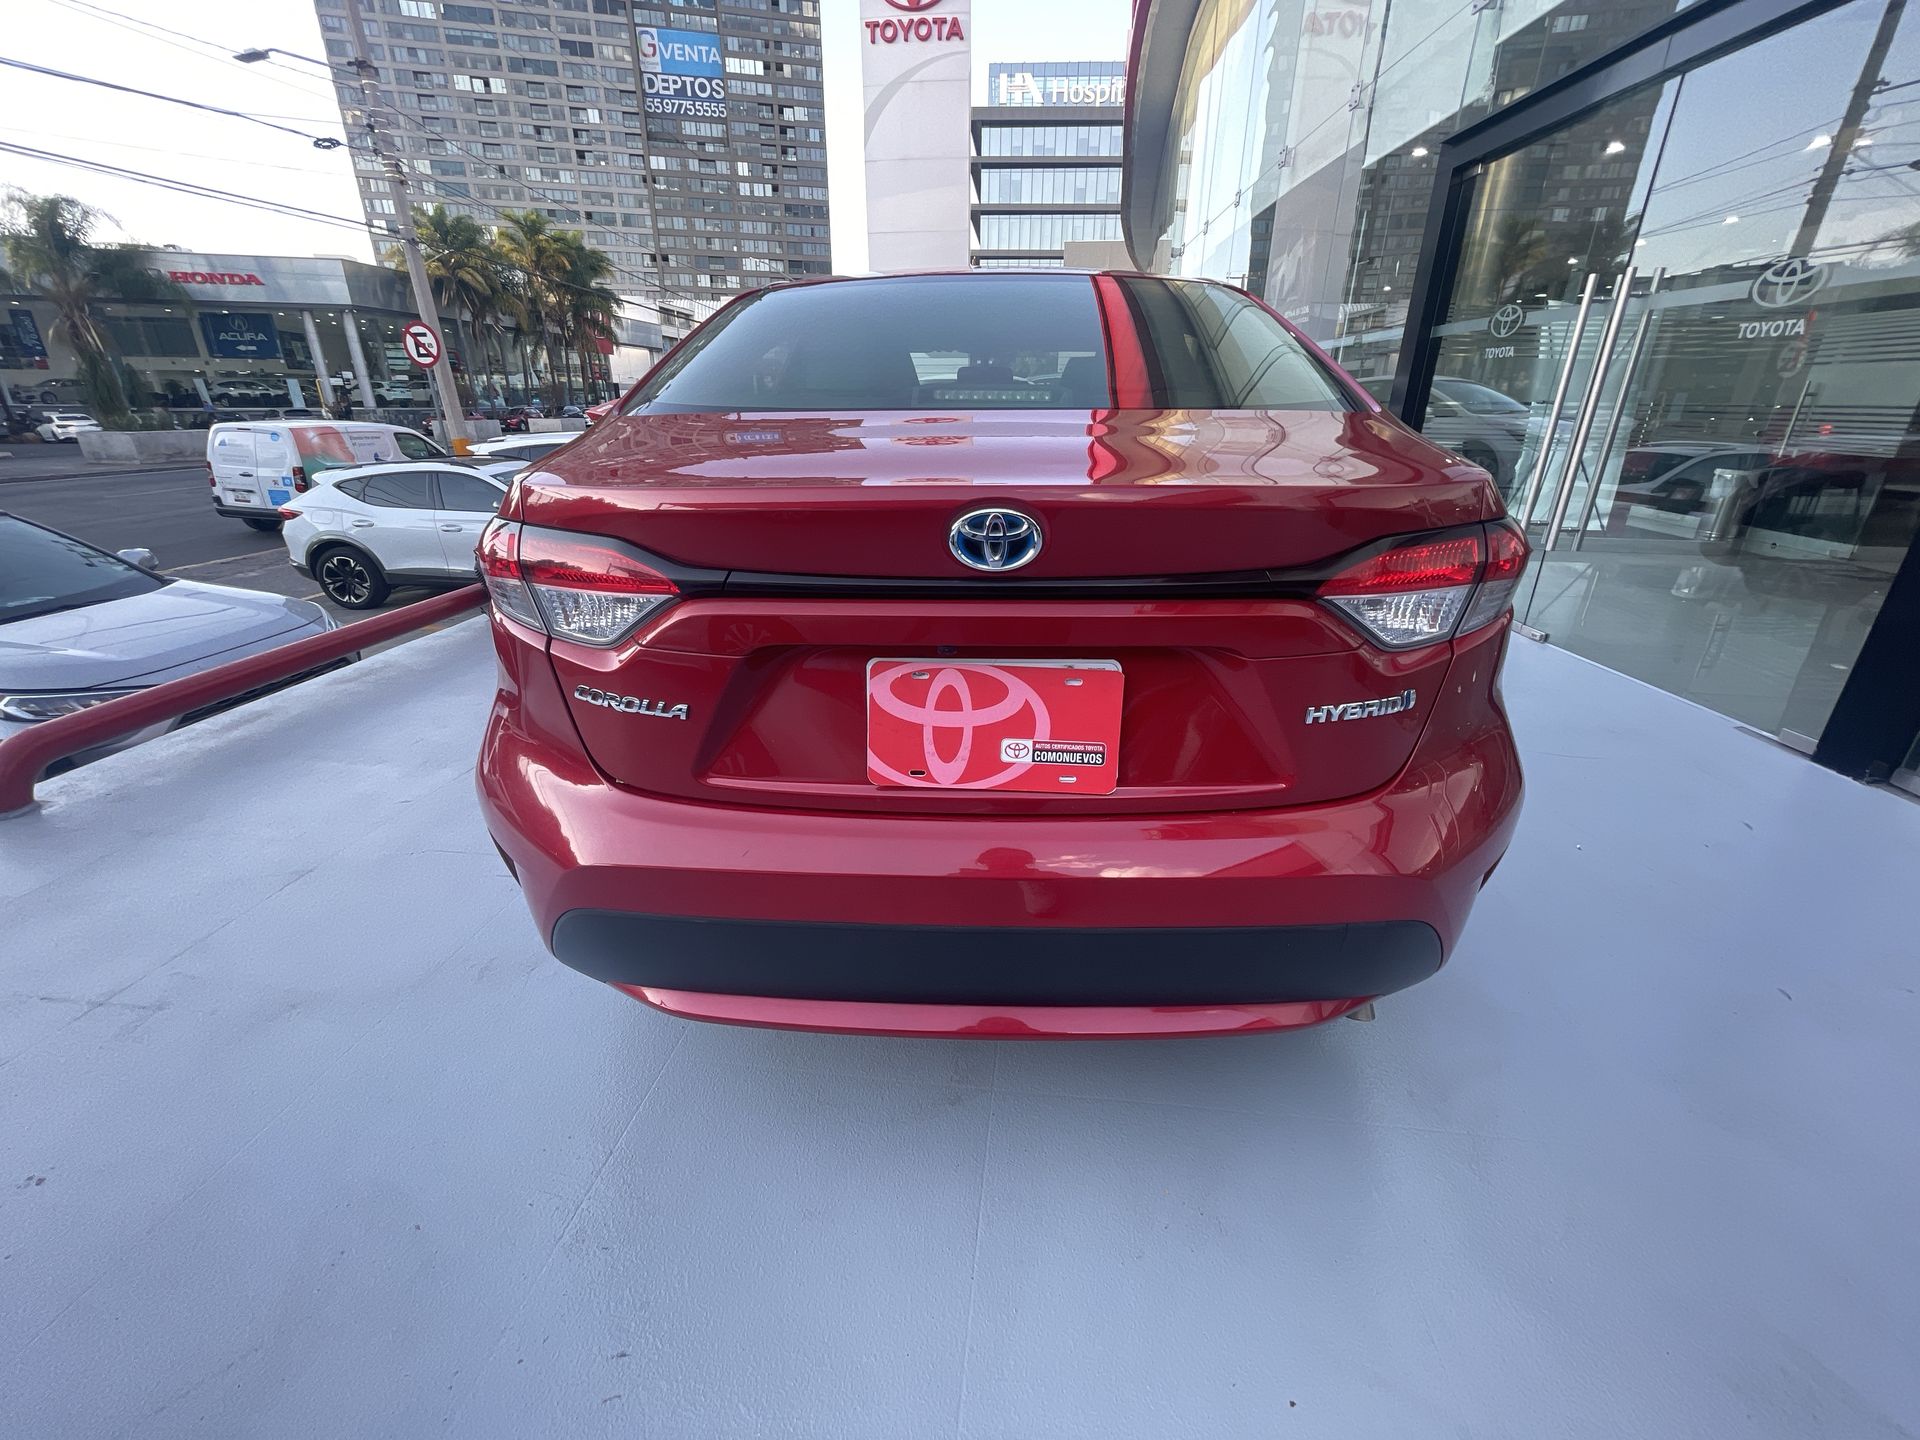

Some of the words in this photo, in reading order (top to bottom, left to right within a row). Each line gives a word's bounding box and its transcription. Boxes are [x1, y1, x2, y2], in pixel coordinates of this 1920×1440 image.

[865, 17, 964, 44] TOYOTA
[659, 41, 722, 65] VENTA
[643, 72, 725, 99] DEPTOS
[645, 97, 727, 118] 5597755555
[167, 270, 266, 286] HONDA
[219, 332, 268, 342] ACURA
[1738, 318, 1805, 339] TOYOTA
[1484, 345, 1515, 359] TOYOTA
[573, 684, 689, 720] COROLLA
[1305, 693, 1410, 724] HYBRID
[1034, 751, 1103, 764] COMONUEVOS
